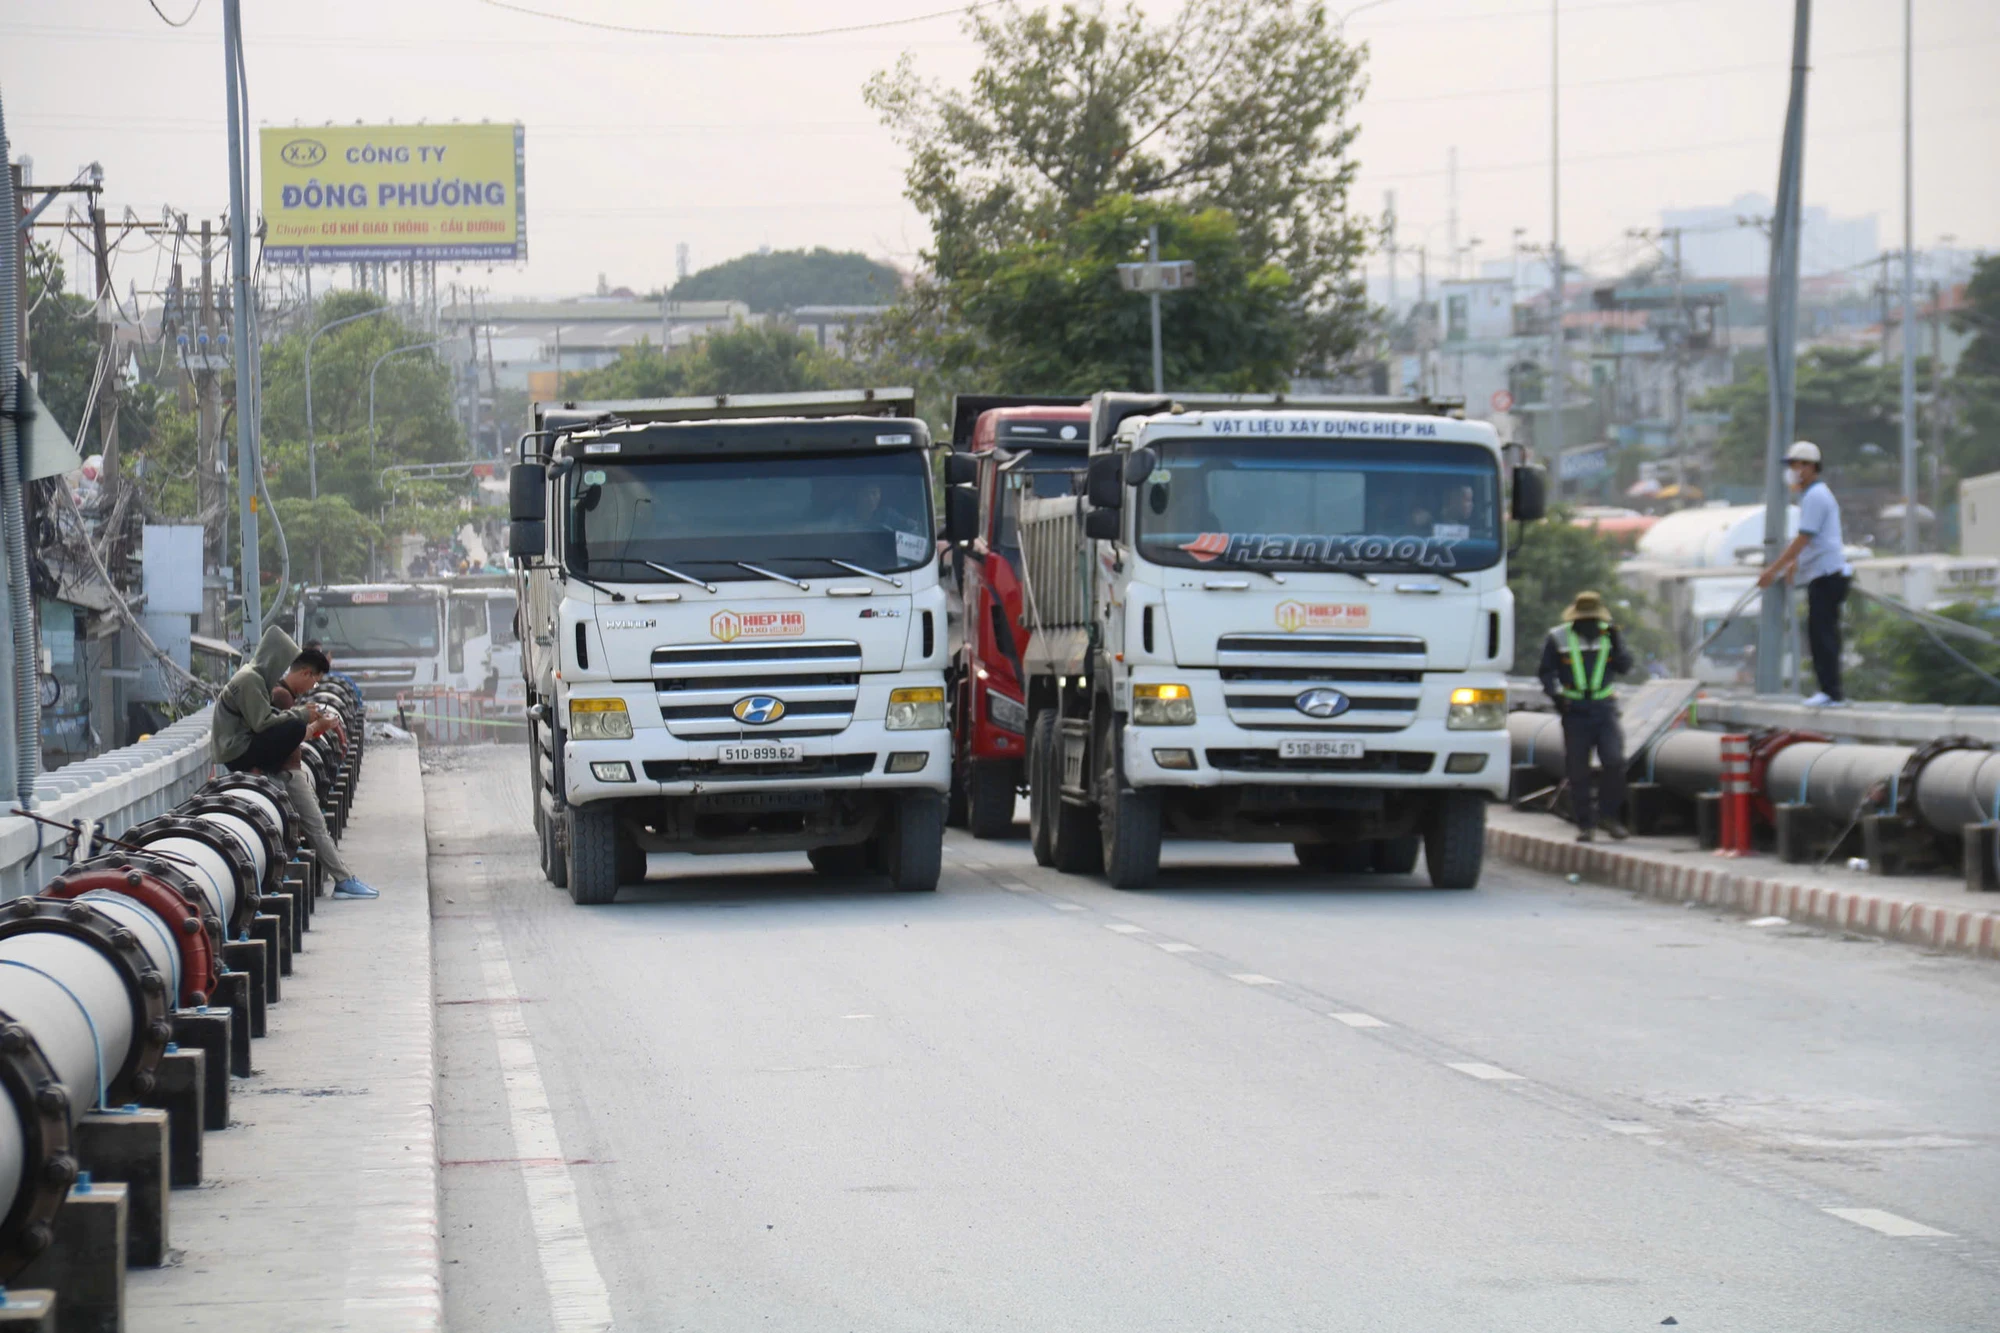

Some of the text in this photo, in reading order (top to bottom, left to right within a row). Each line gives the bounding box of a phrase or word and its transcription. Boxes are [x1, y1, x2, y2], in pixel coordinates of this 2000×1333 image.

[346, 143, 447, 164] CÔNG TY
[378, 177, 505, 206] PHƯƠNG
